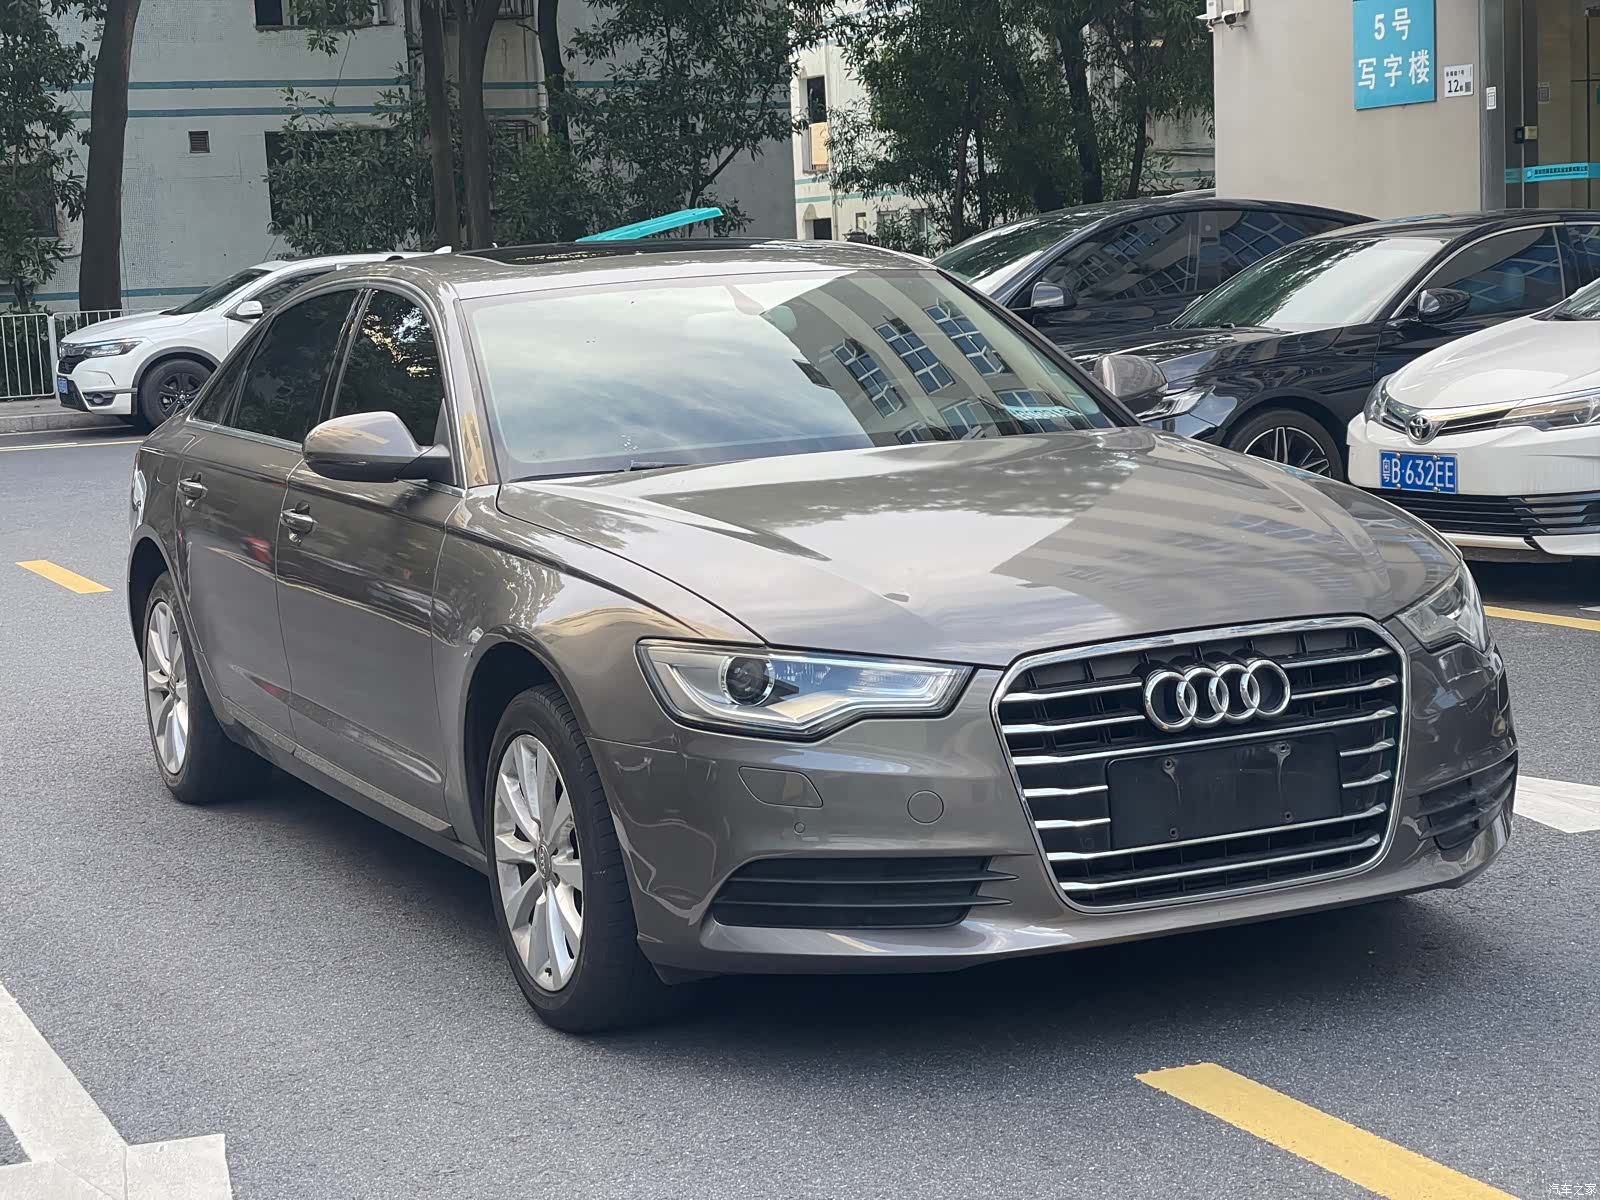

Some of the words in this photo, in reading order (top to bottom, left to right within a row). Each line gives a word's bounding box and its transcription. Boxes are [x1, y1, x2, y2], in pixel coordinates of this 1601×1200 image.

[1374, 7, 1411, 40] 5号
[1358, 49, 1429, 90] 写字楼
